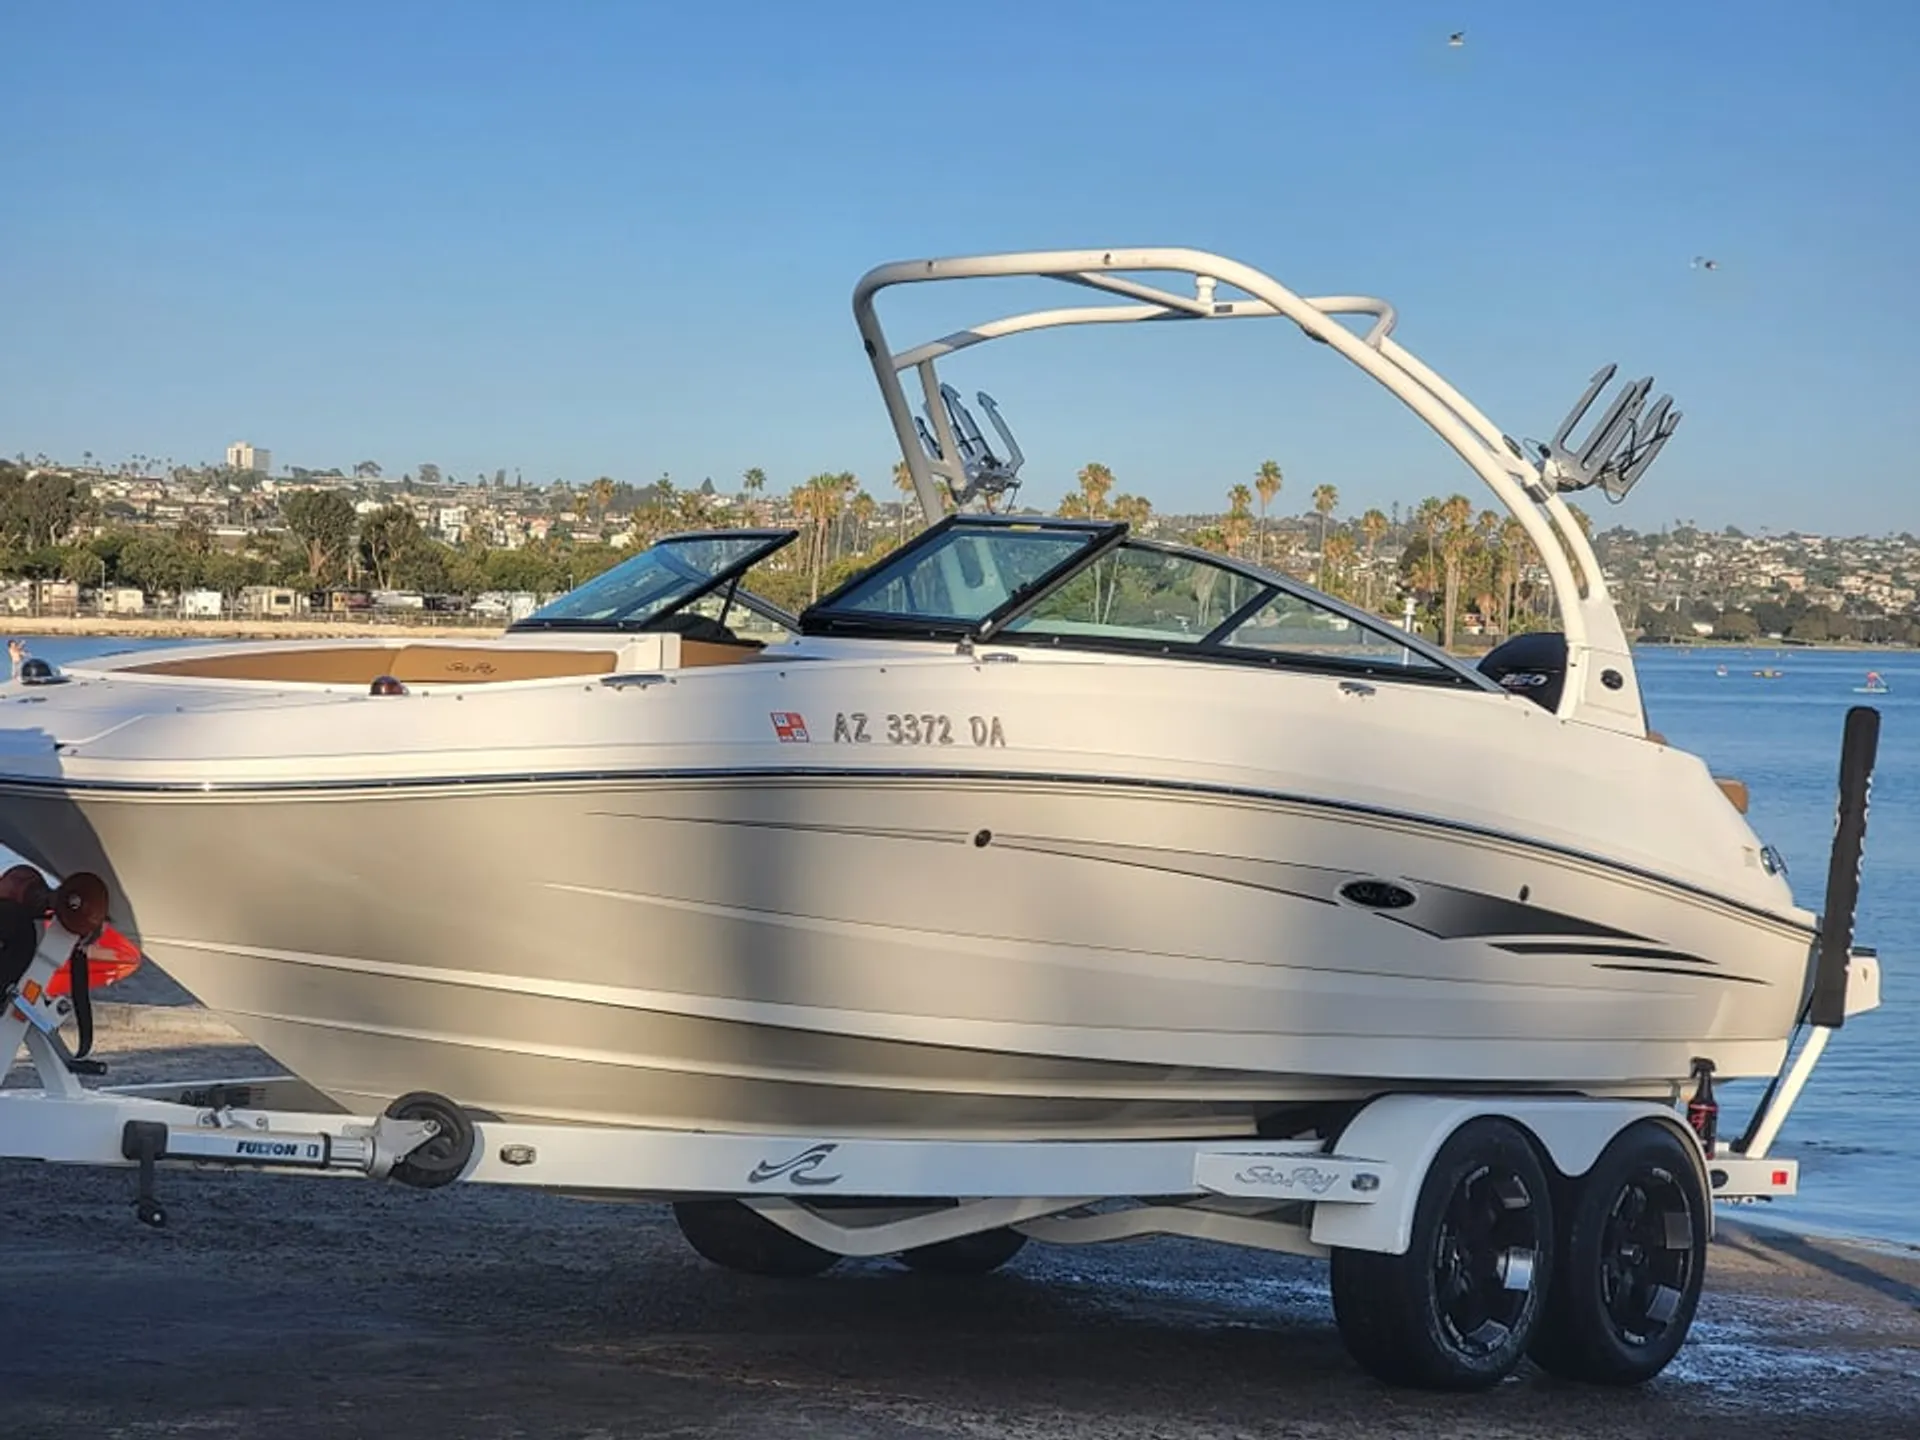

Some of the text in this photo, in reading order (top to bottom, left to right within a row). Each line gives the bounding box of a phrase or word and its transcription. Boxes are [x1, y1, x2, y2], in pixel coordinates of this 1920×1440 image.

[834, 713, 871, 743] AZ
[887, 714, 954, 744] 3372
[236, 1141, 297, 1155] FULTON
